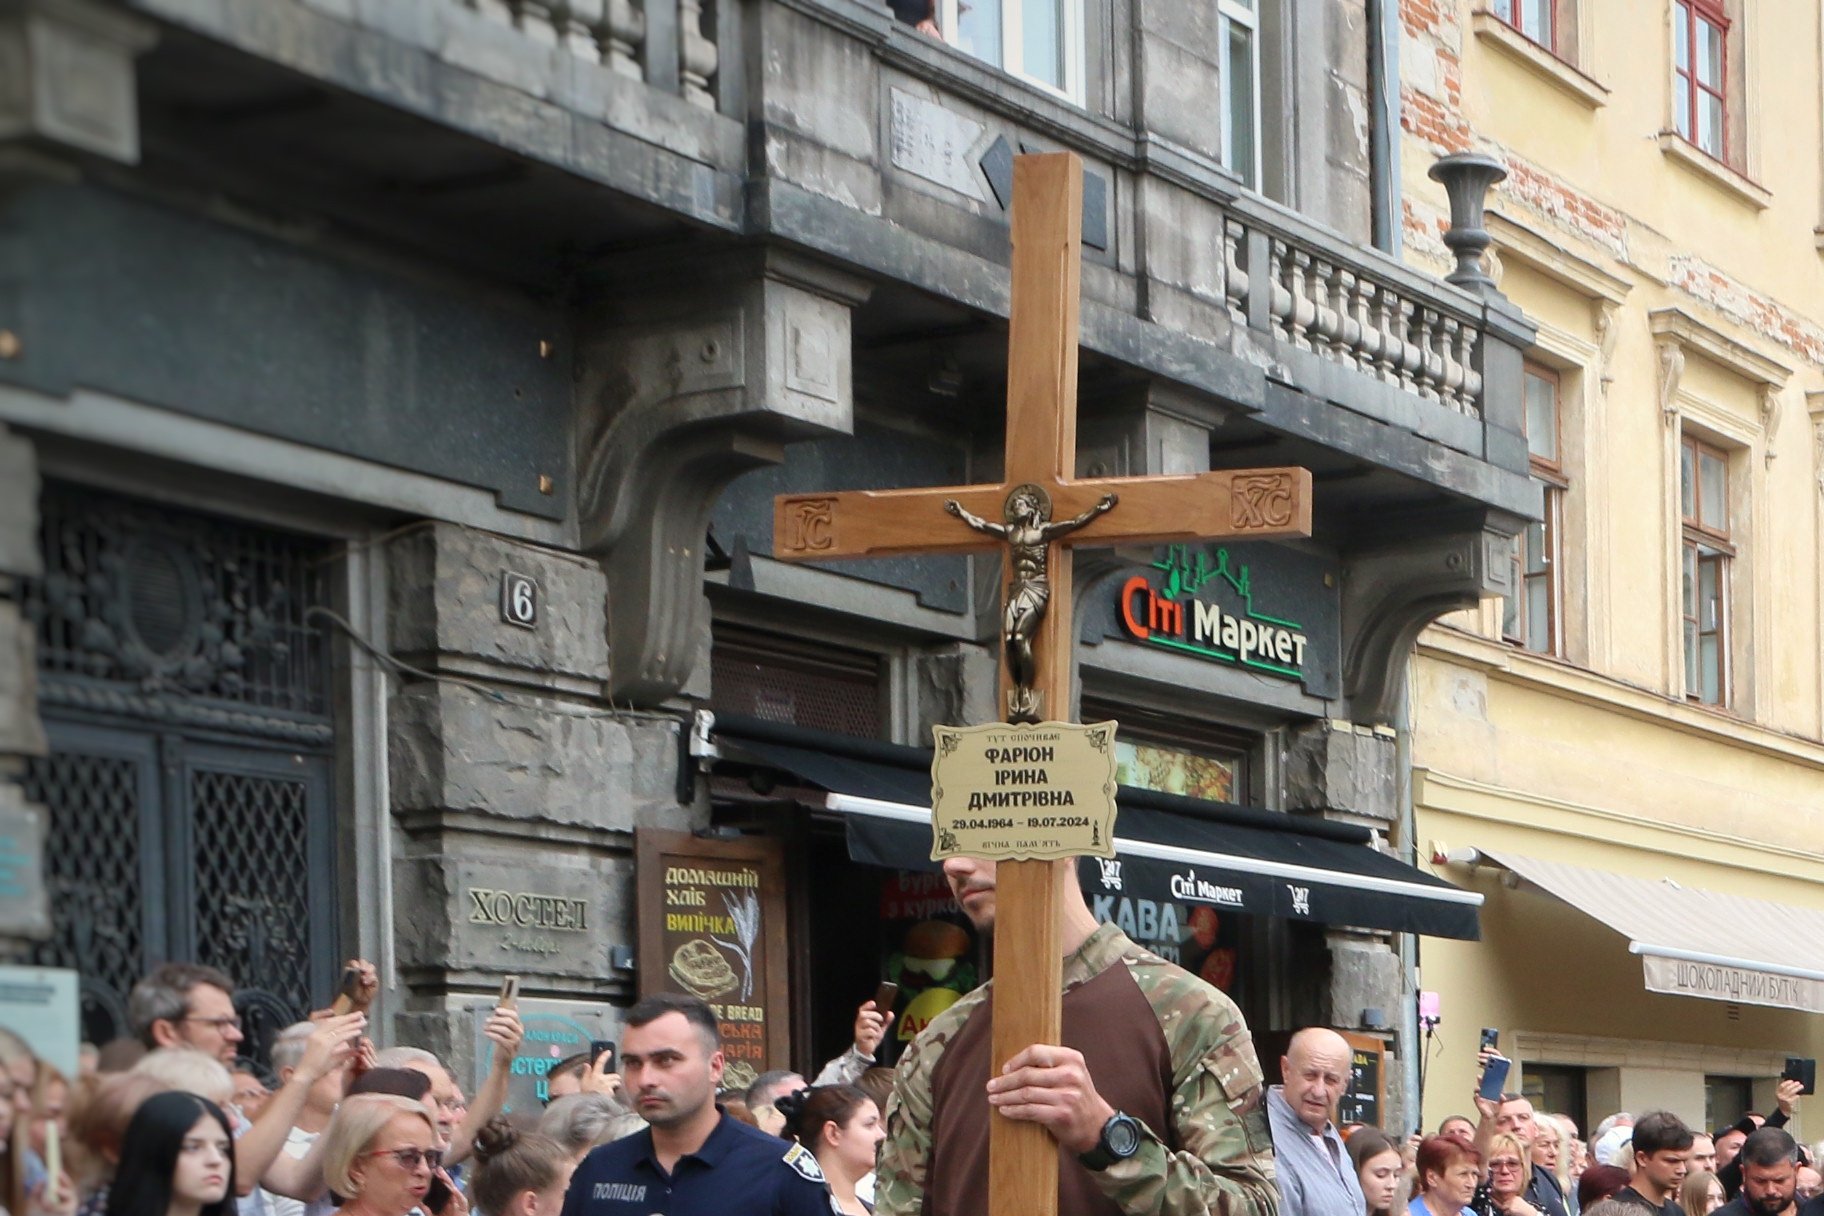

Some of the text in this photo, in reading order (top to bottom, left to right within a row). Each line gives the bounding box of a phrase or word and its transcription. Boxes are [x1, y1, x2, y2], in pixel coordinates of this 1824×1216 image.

[513, 580, 534, 622] 6
[1193, 598, 1308, 666] Маркет
[986, 733, 1061, 743] ТУТ СПОЧИВАЄ
[984, 746, 1054, 765] ФАРІОН
[994, 769, 1048, 786] ІРИНА
[967, 790, 1075, 812] ДМИТРІВНА
[951, 818, 1014, 830] 29.04.1964
[1027, 816, 1090, 828] 19.07.2024
[981, 840, 1010, 849] ВІЧНА
[1197, 879, 1243, 903] Маркет
[467, 886, 590, 932] ХОСТЕЛ
[1093, 893, 1182, 944] КАВА
[666, 911, 737, 935] ВИПІЧКА
[1676, 962, 1799, 1002] ШОКОЛАДНИЙ БУТІК
[727, 1004, 764, 1022] BREAD
[592, 1182, 648, 1203] ПОЛІЦІЯ
